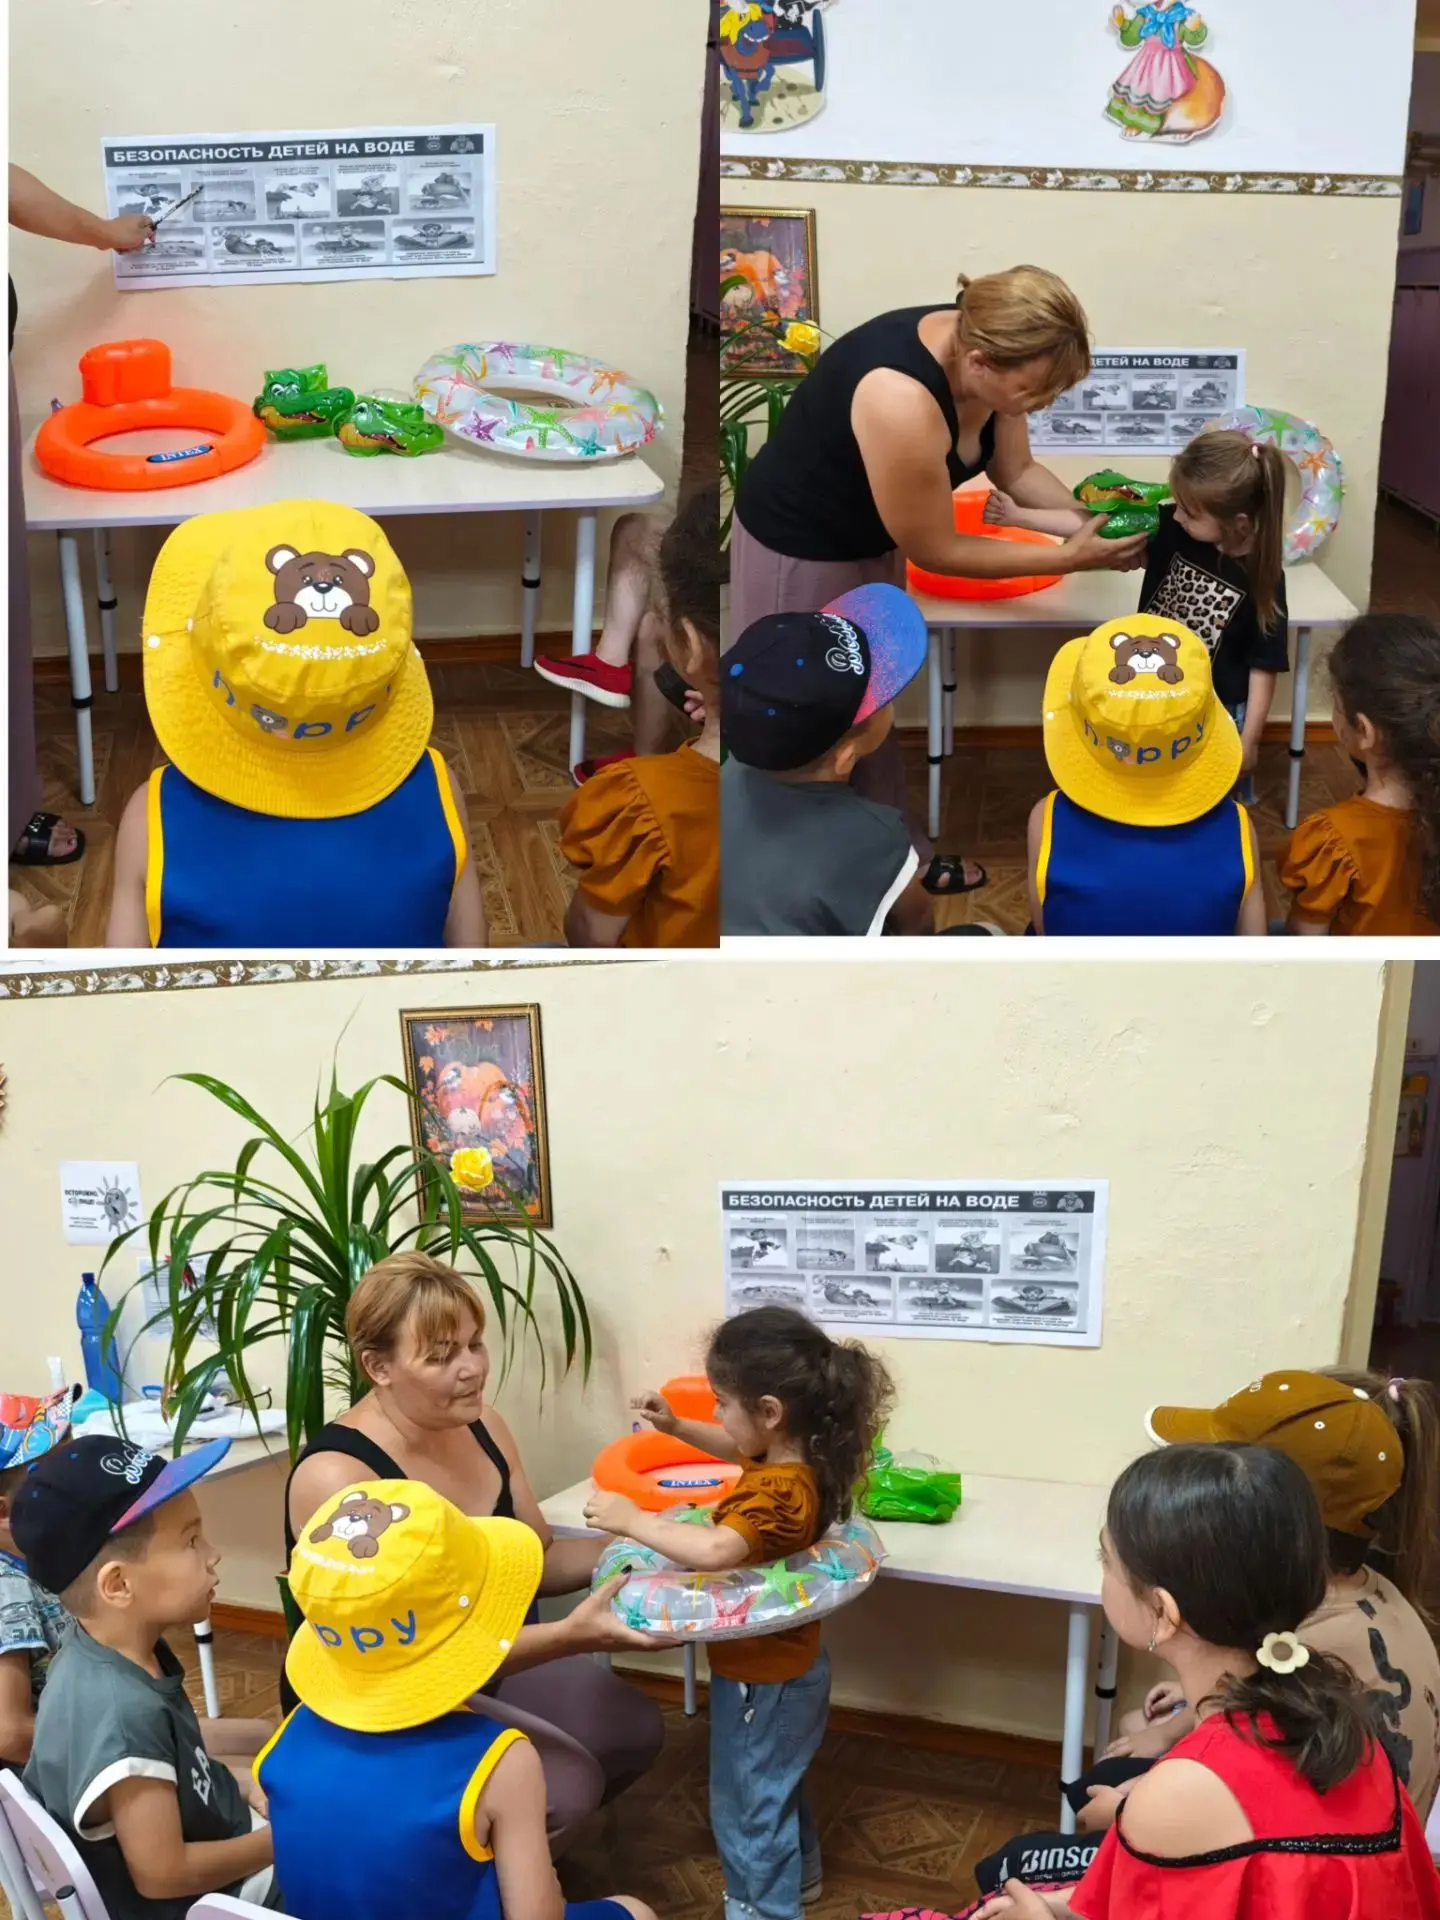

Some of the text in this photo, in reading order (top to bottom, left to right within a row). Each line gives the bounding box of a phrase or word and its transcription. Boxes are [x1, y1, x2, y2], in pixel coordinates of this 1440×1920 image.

[113, 140, 416, 163] БЕЗОПАСНОСТЬ ДЕТЕЙ НА ВОДЕ
[1132, 357, 1151, 366] НА
[1153, 357, 1190, 368] ВОДЕ
[160, 446, 203, 461] INTEX
[729, 1193, 1020, 1209] БЕЗОПАСНОСТЬ ДЕТЕЙ НА ВОДЕ
[670, 1479, 712, 1488] INTEX
